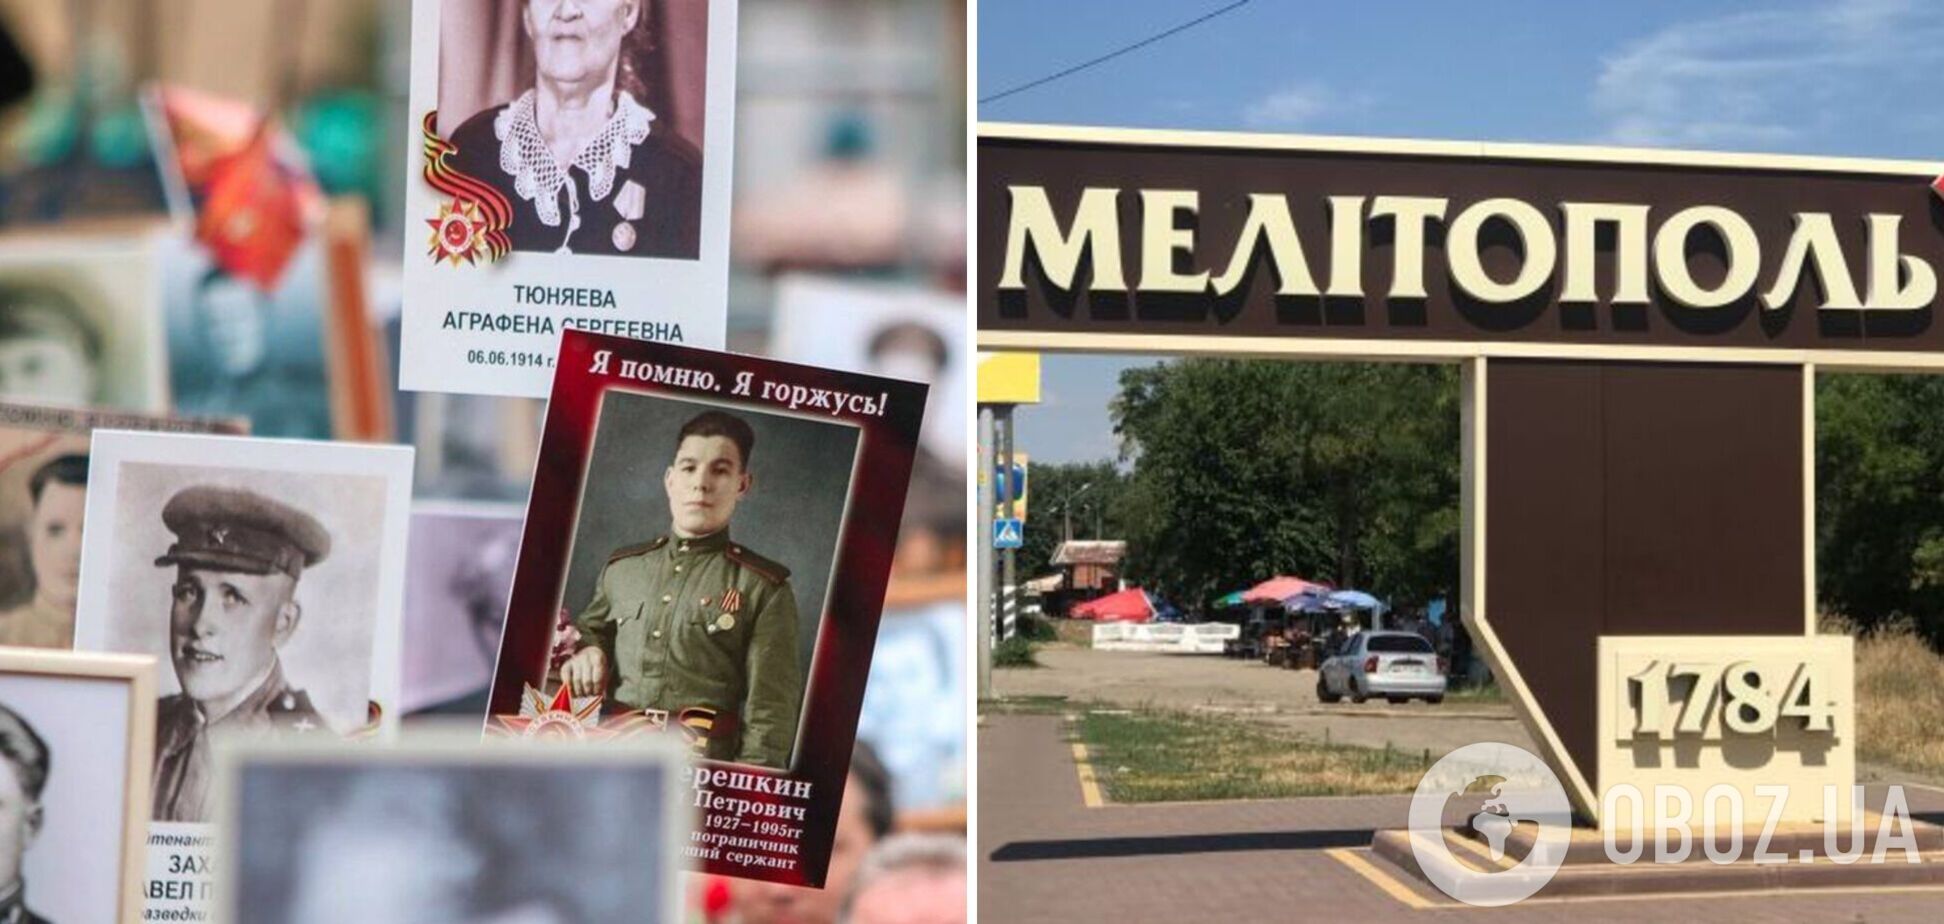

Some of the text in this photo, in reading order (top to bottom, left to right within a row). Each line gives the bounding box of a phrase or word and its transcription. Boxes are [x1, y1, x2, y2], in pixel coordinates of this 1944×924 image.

[998, 185, 1938, 310] МЕЛІТОПОЛЬ
[513, 285, 617, 308] ТЮНЯЕВА
[442, 311, 555, 335] АГРАФЕНА
[467, 349, 543, 368] 06.06.1914
[588, 350, 889, 417] Я помню. Я горжусь!
[1627, 660, 1838, 734] 1784
[693, 790, 807, 822] Петрович
[691, 830, 799, 855] пограничник
[726, 850, 797, 870] сержант
